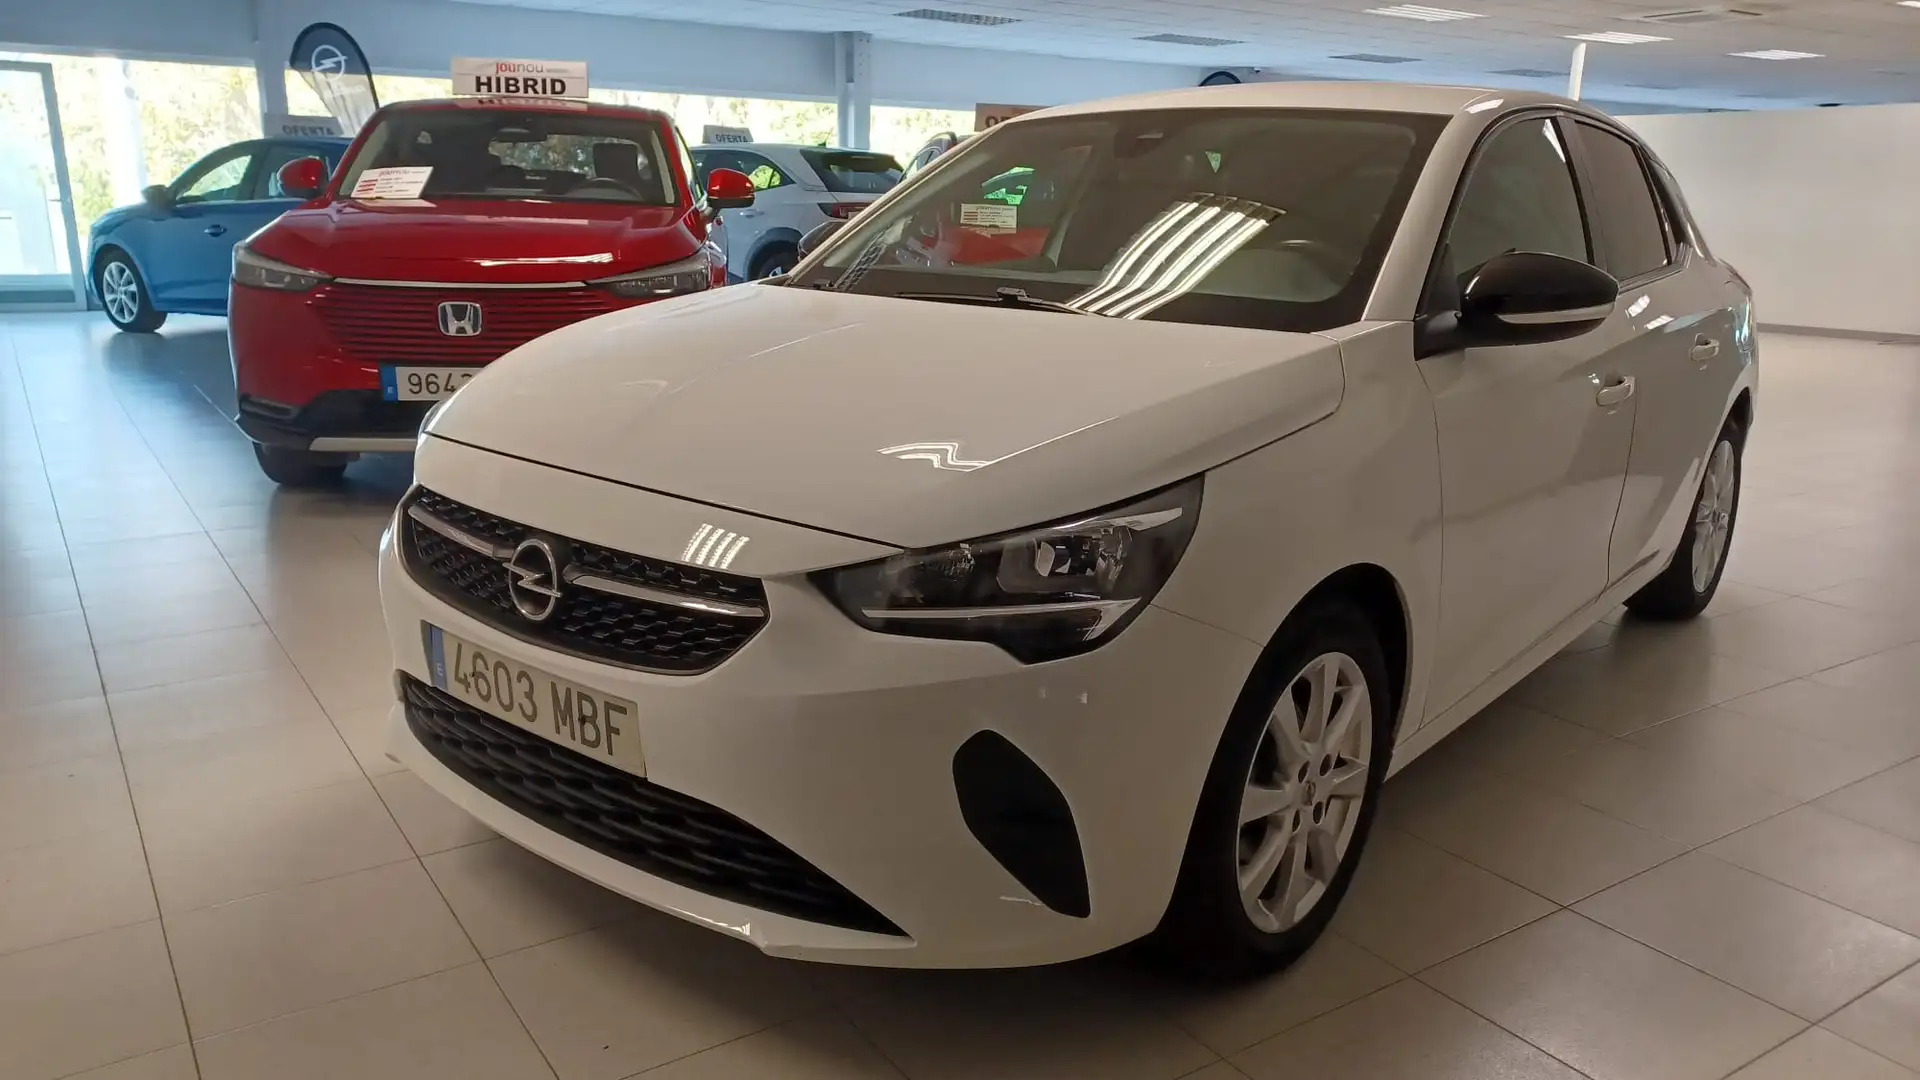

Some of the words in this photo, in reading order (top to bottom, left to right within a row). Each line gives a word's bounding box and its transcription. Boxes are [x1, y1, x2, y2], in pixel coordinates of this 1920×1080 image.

[495, 62, 544, 74] jounou
[475, 76, 566, 95] HIBRID
[282, 124, 334, 136] OFERTA
[715, 133, 748, 143] OFERTA
[453, 642, 538, 723] 4603
[550, 680, 628, 756] MBF
